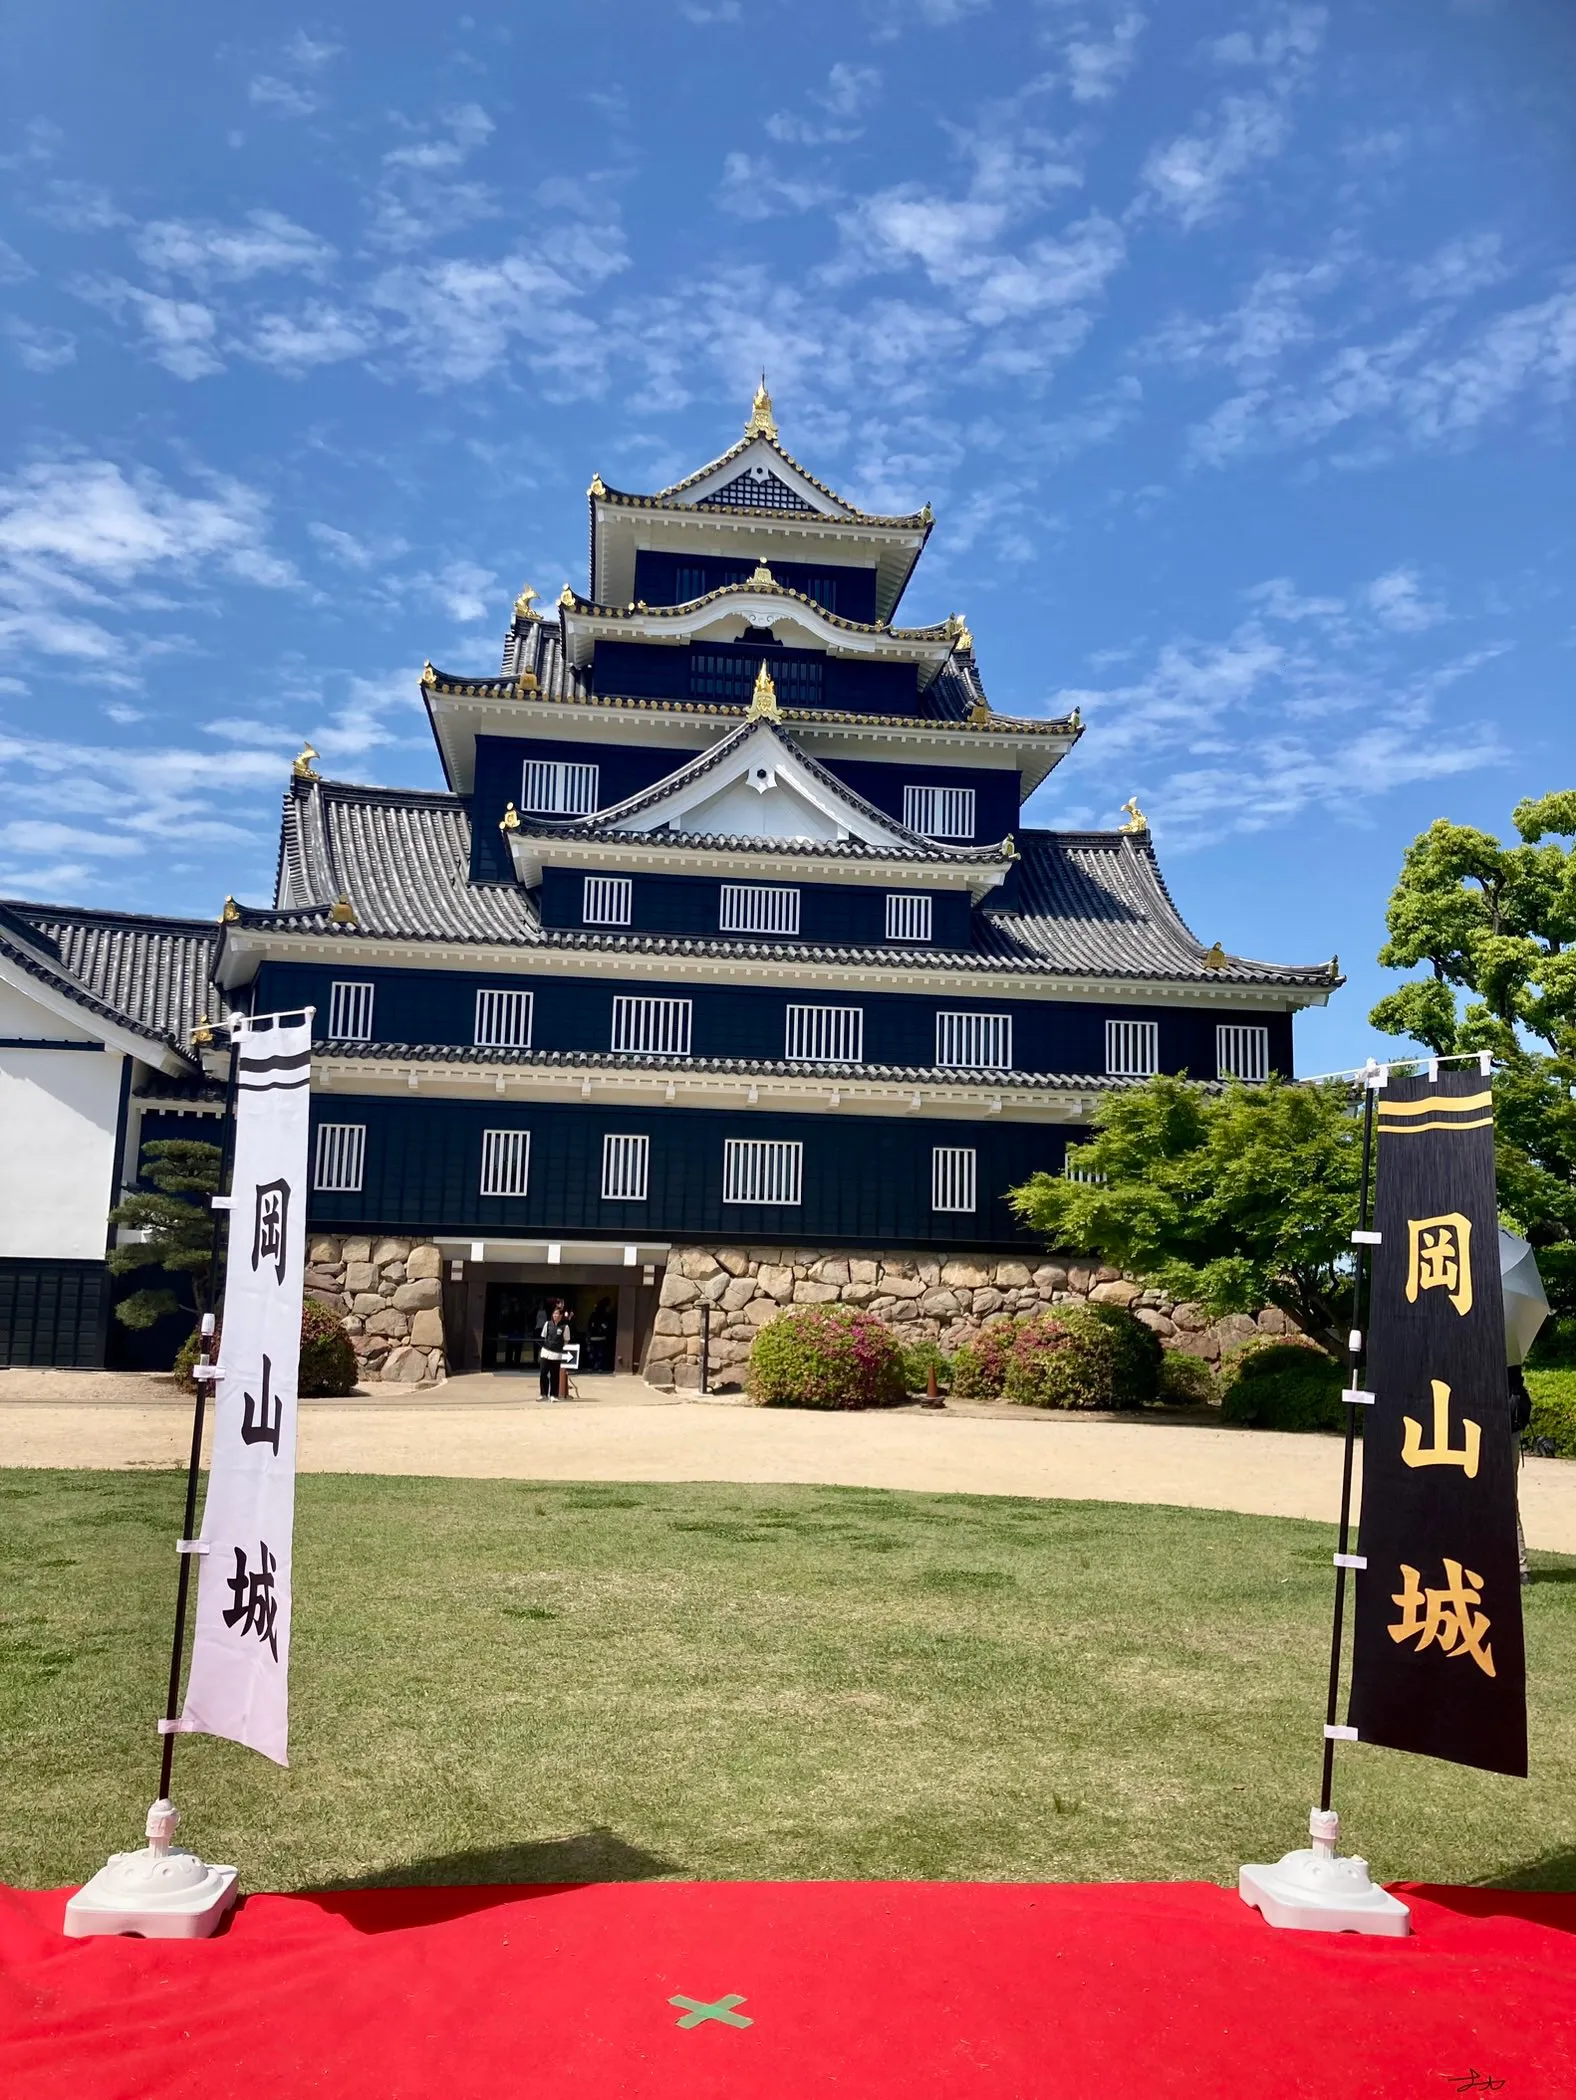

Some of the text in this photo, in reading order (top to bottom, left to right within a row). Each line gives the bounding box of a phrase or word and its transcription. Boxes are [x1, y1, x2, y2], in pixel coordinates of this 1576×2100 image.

[222, 1177, 291, 1664] 岡山城
[1387, 1212, 1497, 1678] 岡山城
